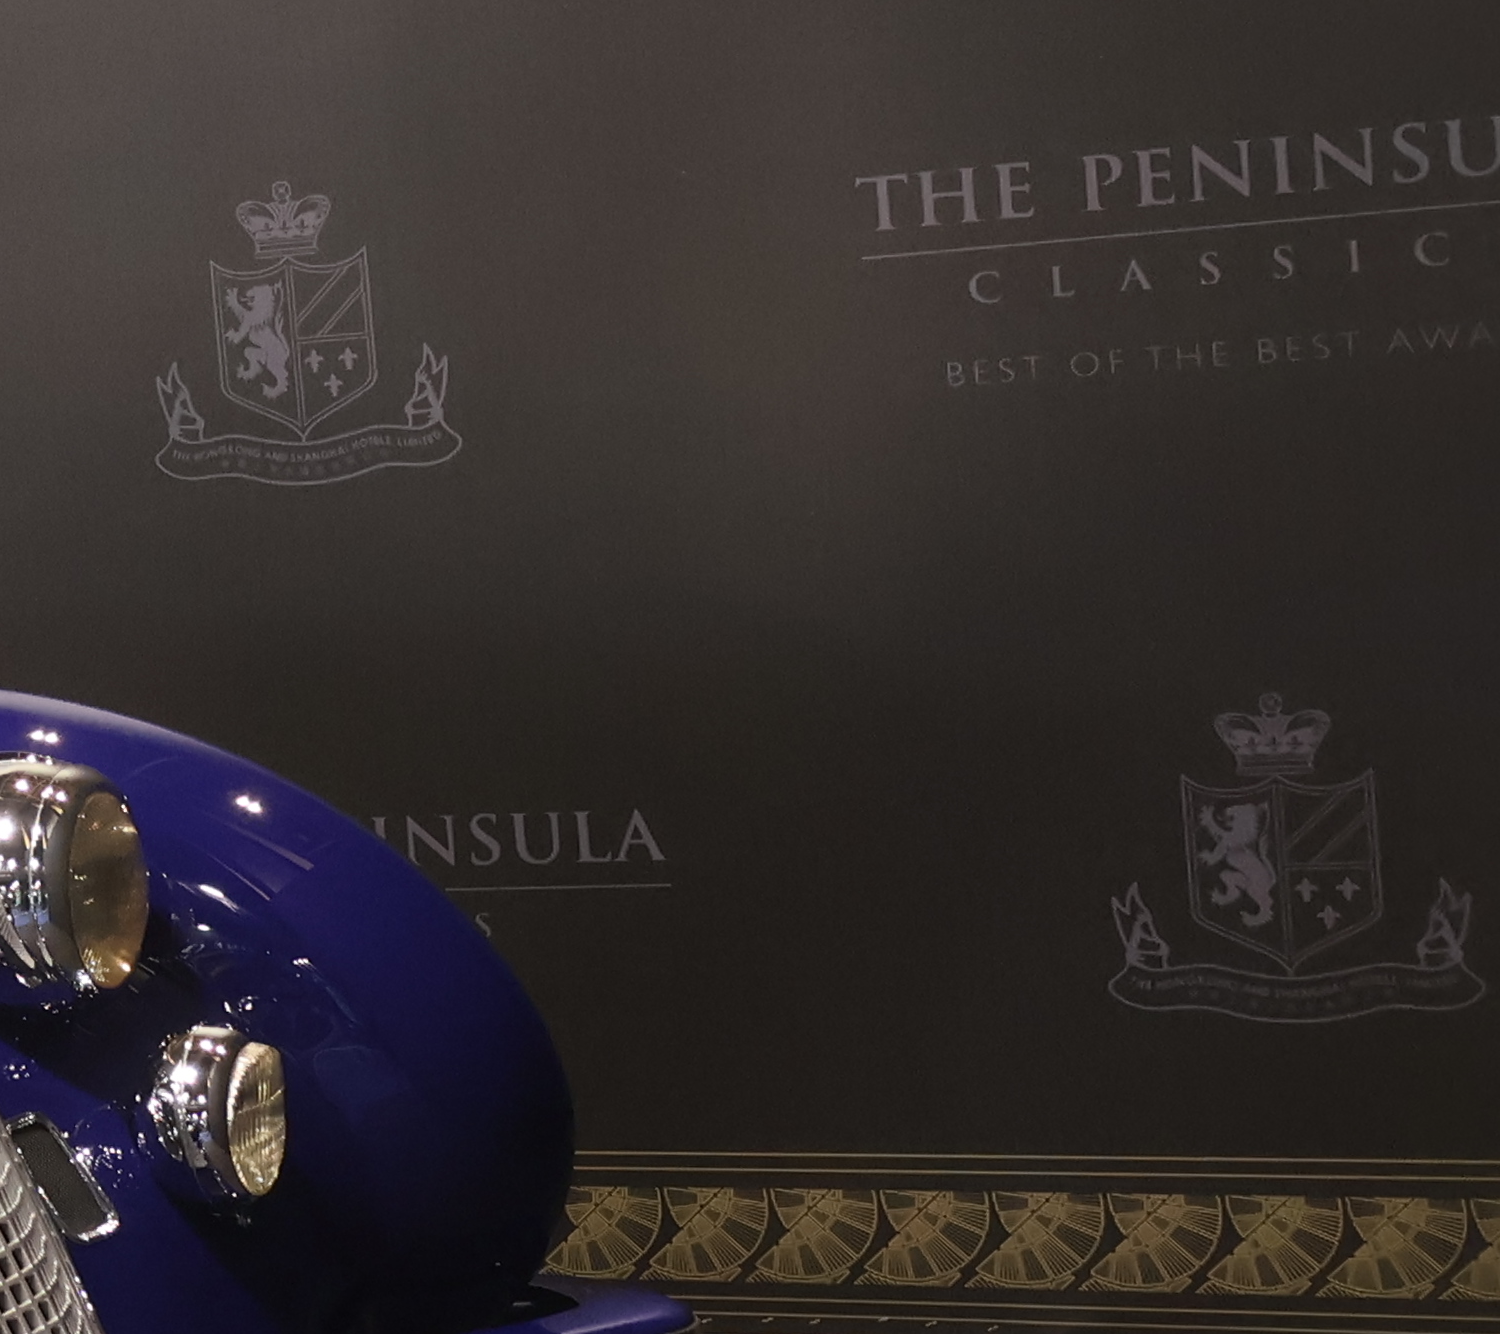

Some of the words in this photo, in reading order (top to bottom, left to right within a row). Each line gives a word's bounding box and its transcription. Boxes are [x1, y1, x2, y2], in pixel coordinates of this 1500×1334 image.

[855, 160, 1035, 232] THE
[946, 354, 1042, 389] BEST
[1069, 347, 1126, 378] OF
[1145, 339, 1228, 372] THE
[1255, 329, 1360, 365] BEST
[372, 808, 667, 867] NSULA
